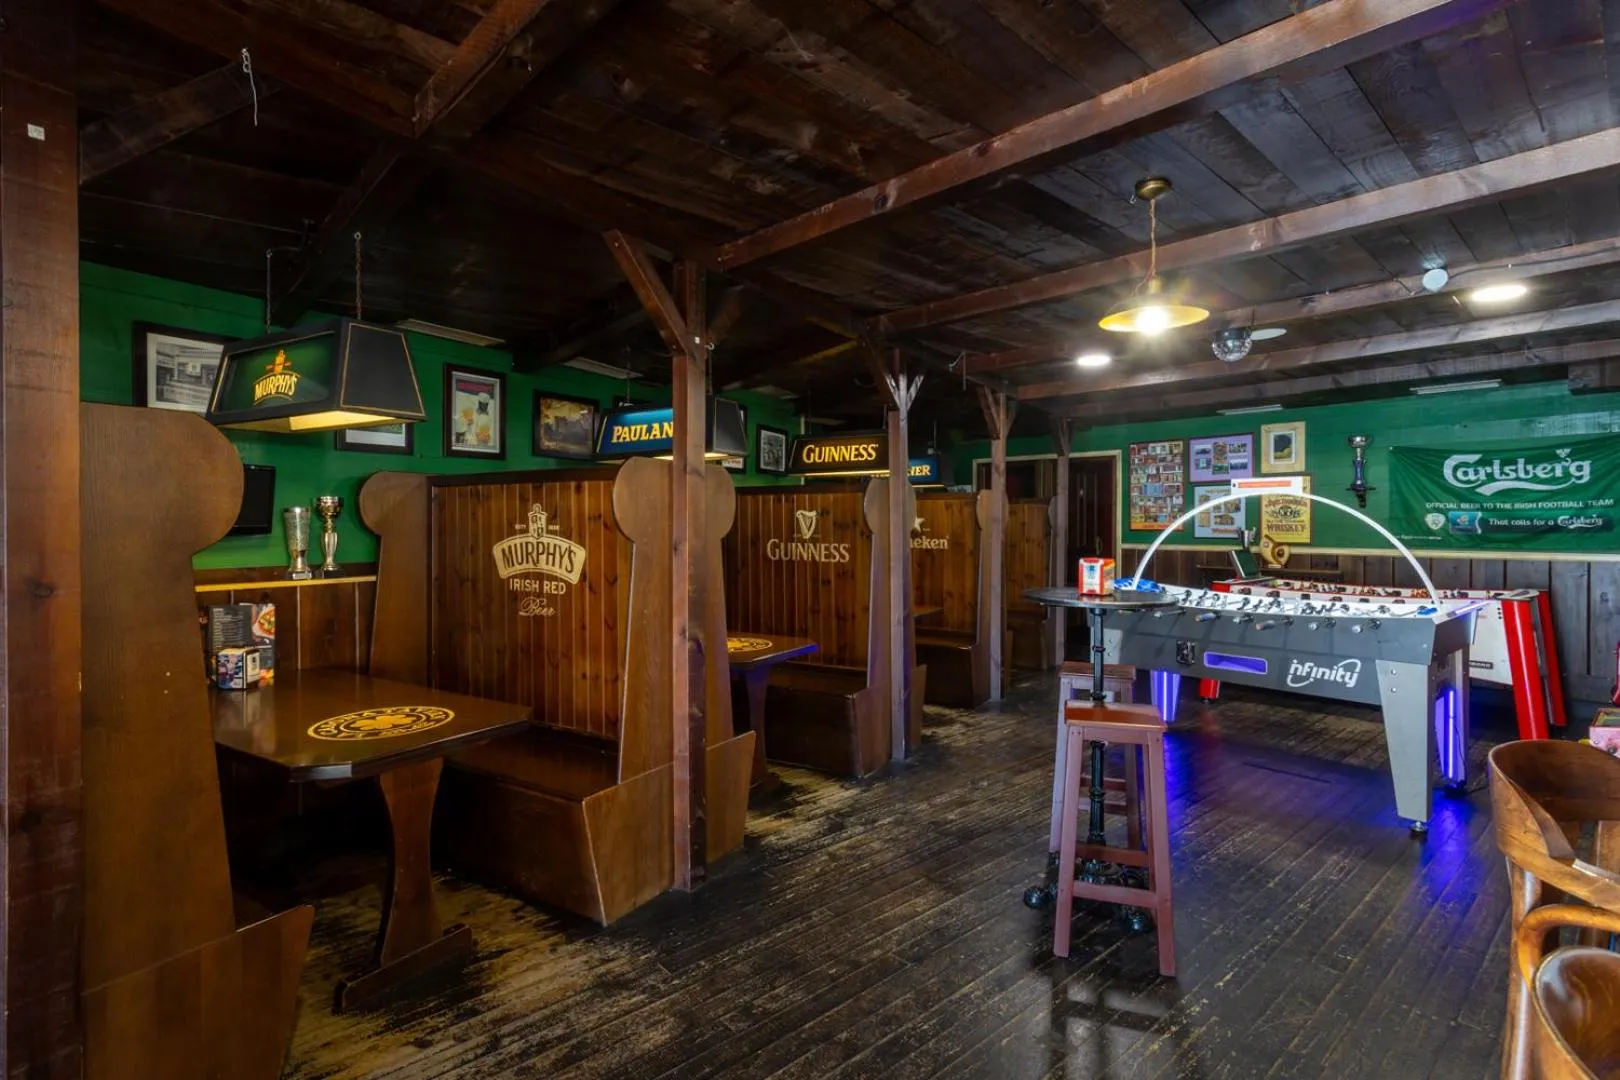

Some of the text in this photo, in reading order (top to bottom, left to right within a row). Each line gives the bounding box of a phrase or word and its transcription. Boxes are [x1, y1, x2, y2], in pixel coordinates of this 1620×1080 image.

[802, 443, 877, 464] GUINNESS
[1443, 454, 1593, 496] Carlsberg
[1538, 500, 1584, 509] FOOTBALL
[1587, 498, 1614, 507] TEAM
[1489, 517, 1509, 526] That
[1533, 518, 1546, 526] for
[501, 541, 577, 574] MURPHY'S
[766, 538, 849, 563] GUINNESS
[509, 579, 566, 595] IRISH RED
